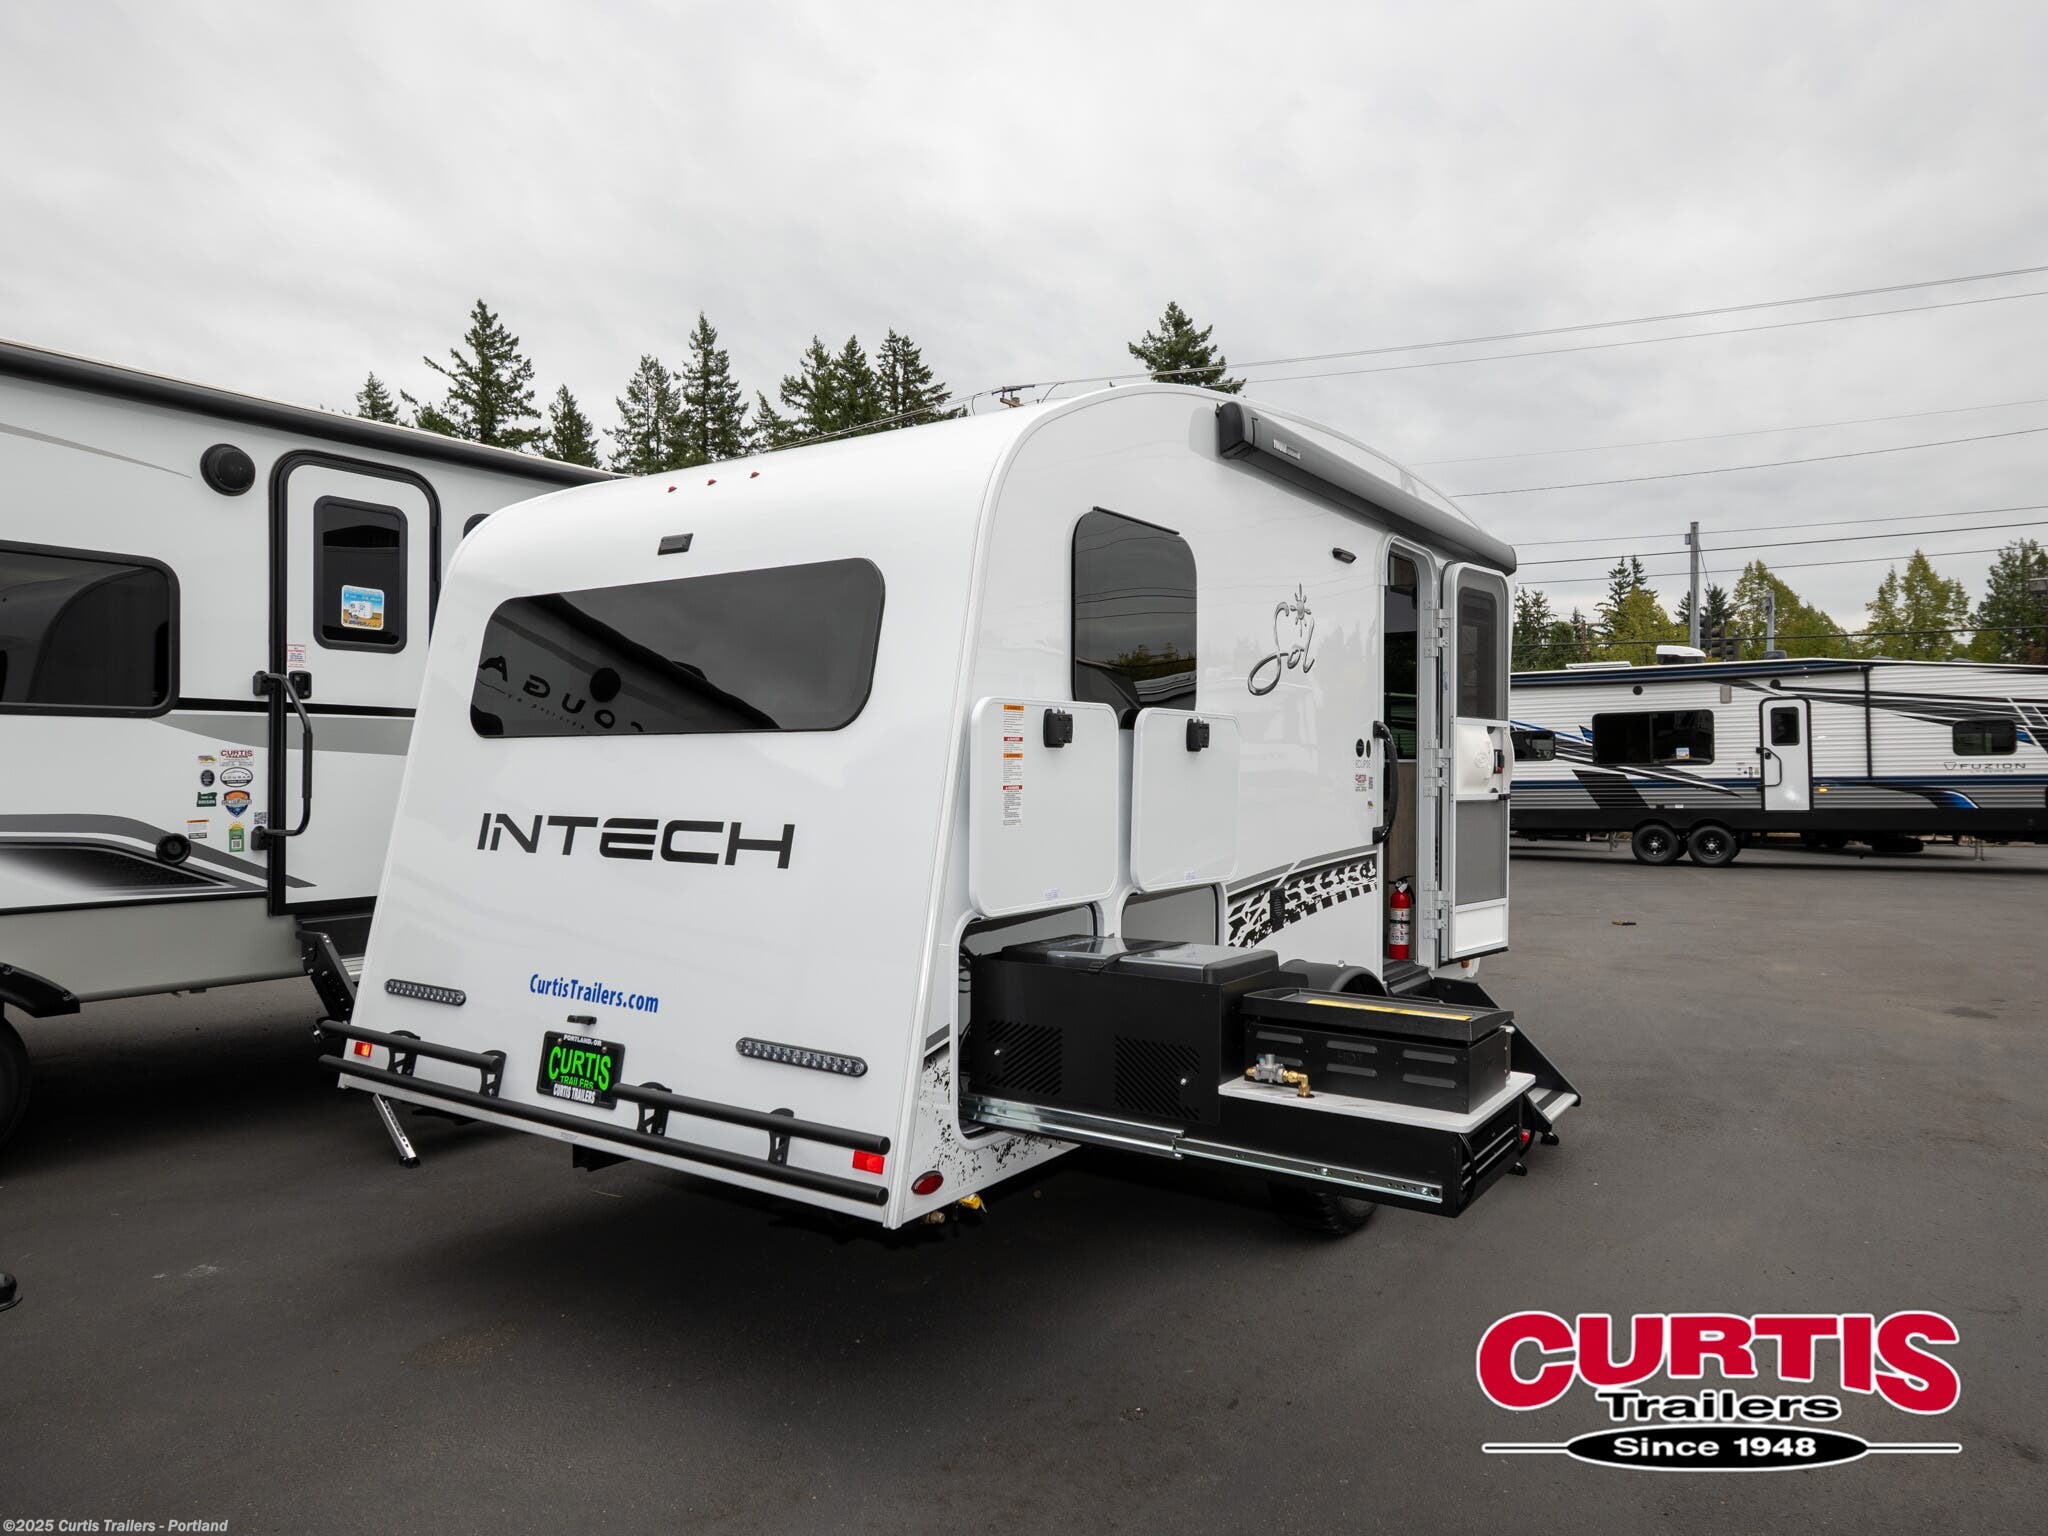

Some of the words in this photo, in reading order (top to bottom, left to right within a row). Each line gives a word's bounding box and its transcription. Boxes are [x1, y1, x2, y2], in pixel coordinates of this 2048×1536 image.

[477, 813, 795, 869] INTECH
[529, 974, 659, 1013] CurtisTrailers.com
[548, 1046, 611, 1091] CURTIS
[553, 1083, 571, 1098] CURTIS
[571, 1087, 595, 1104] TRAILERS
